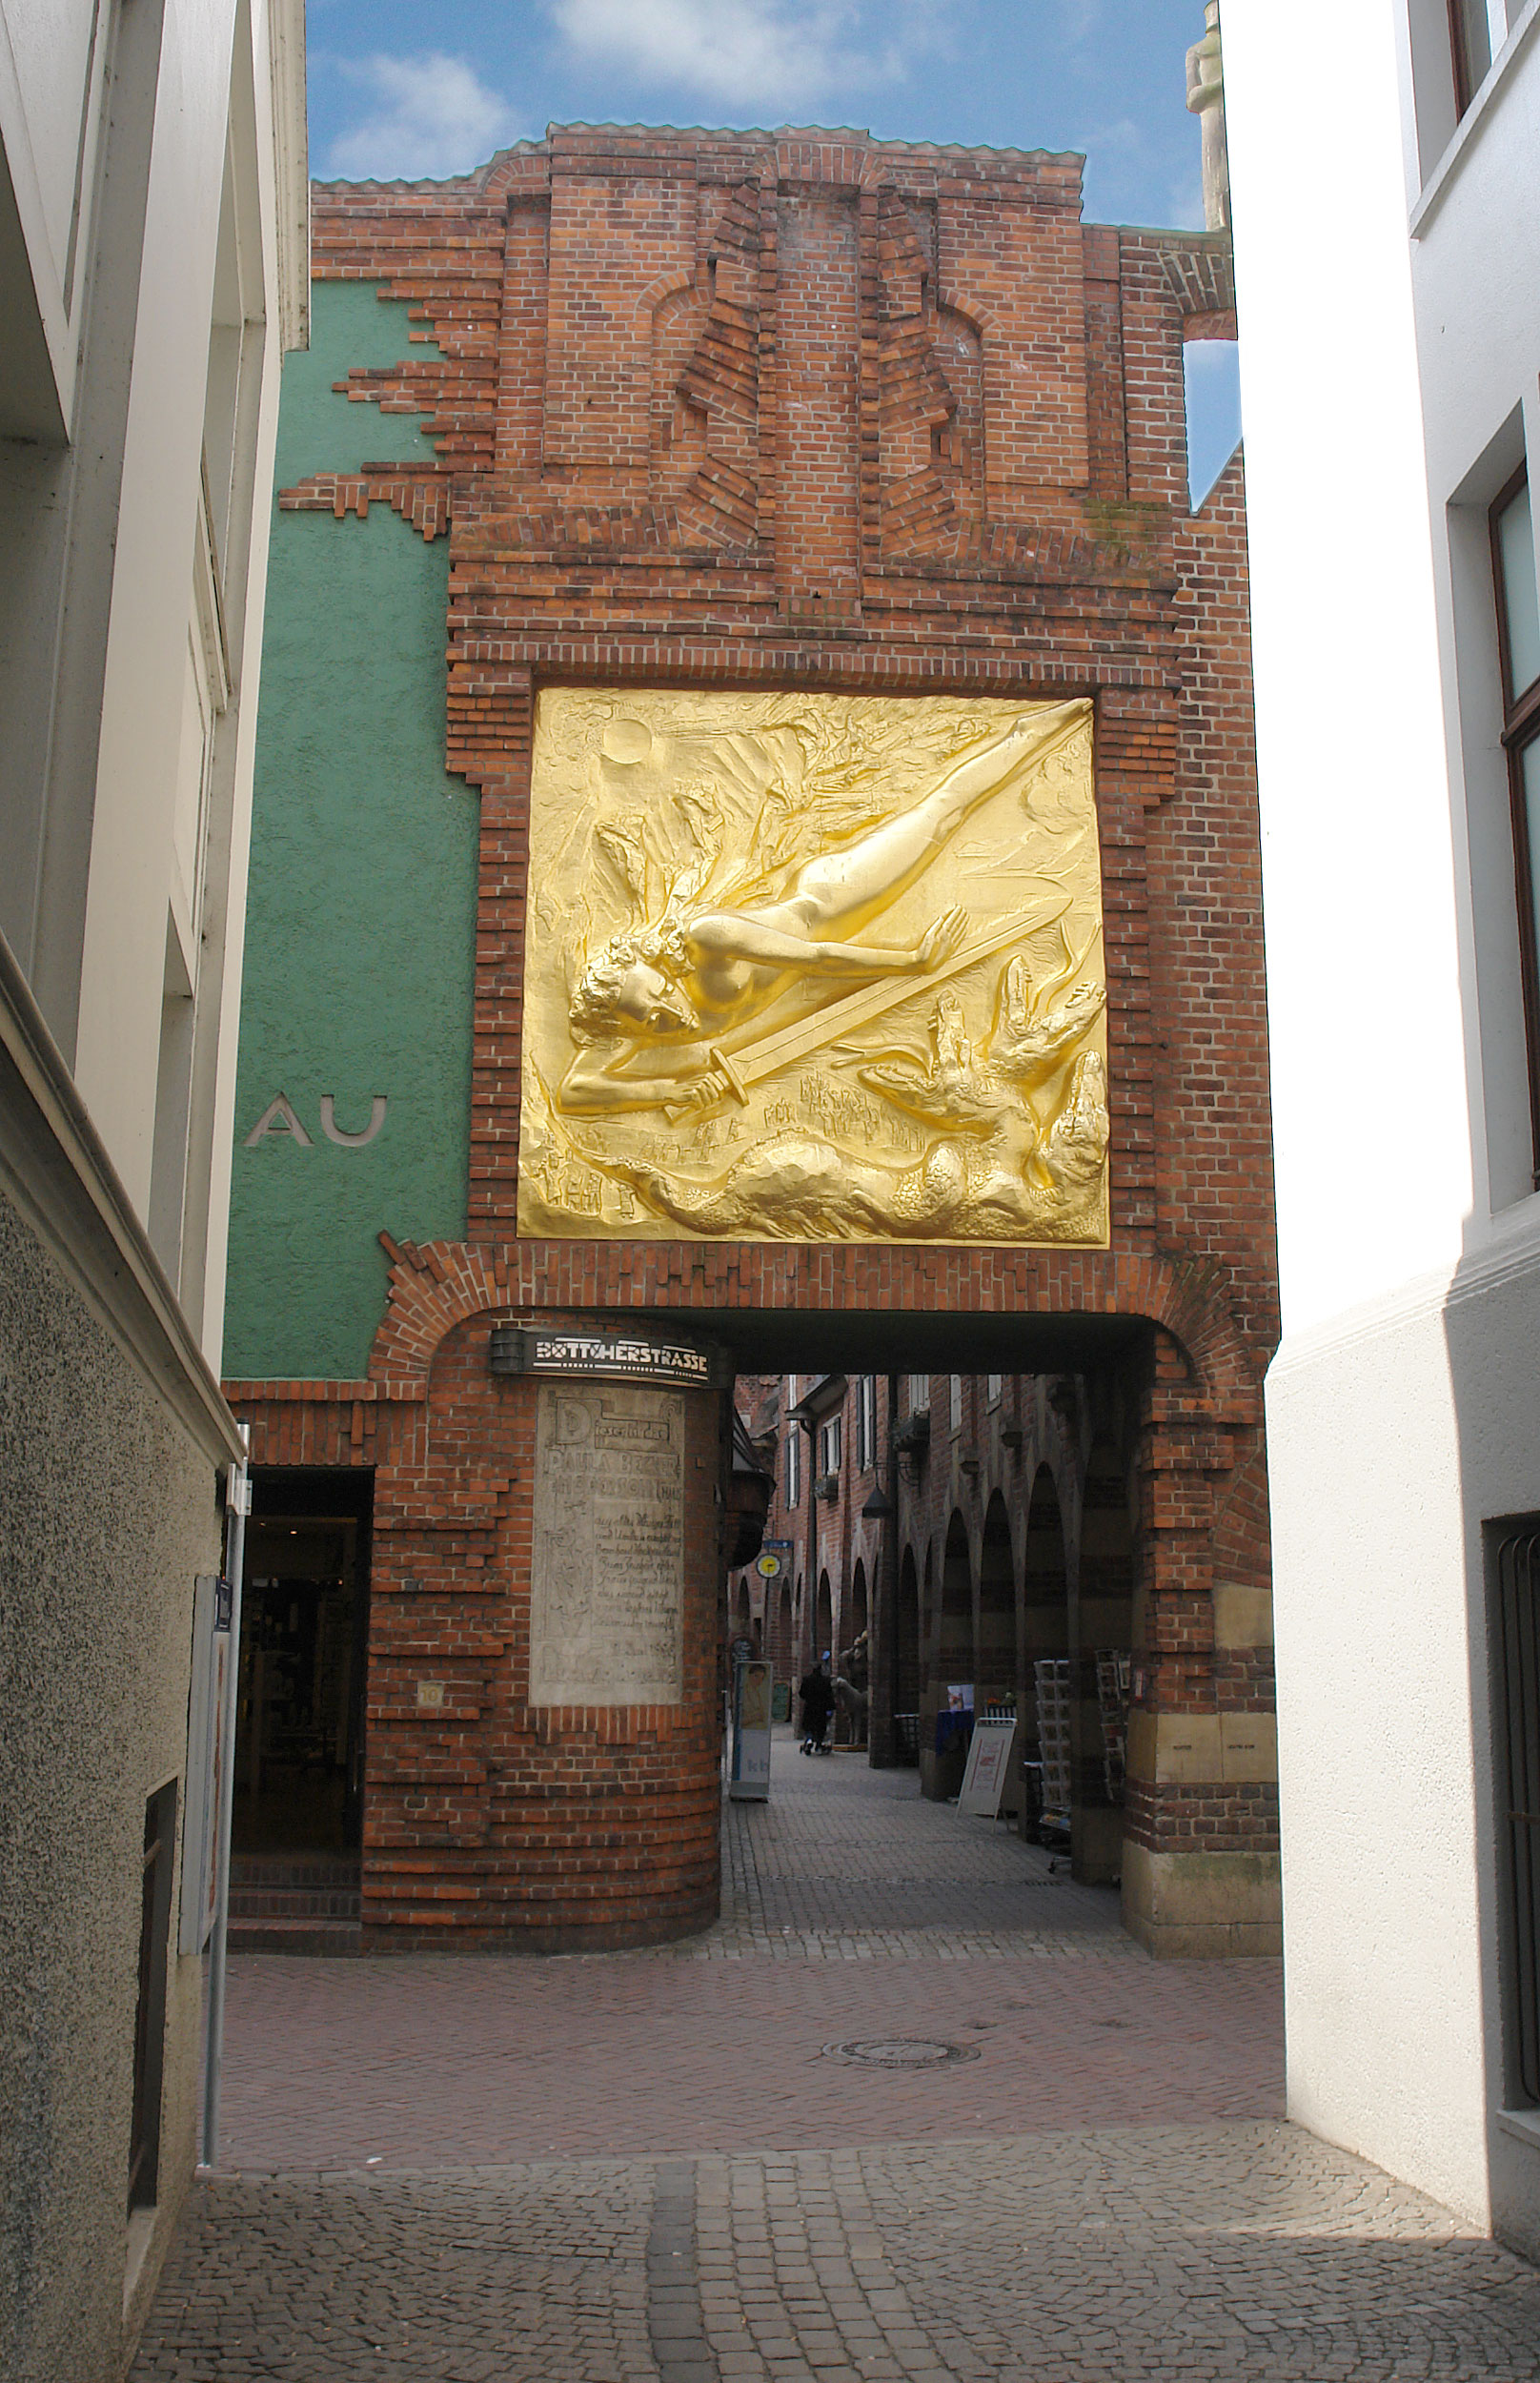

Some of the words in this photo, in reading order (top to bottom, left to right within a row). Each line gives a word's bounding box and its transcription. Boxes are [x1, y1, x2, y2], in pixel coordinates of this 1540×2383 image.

[242, 1090, 388, 1148] AU
[536, 1341, 708, 1373] BÖTTCHERSTRASSE
[420, 1688, 438, 1702] 10
